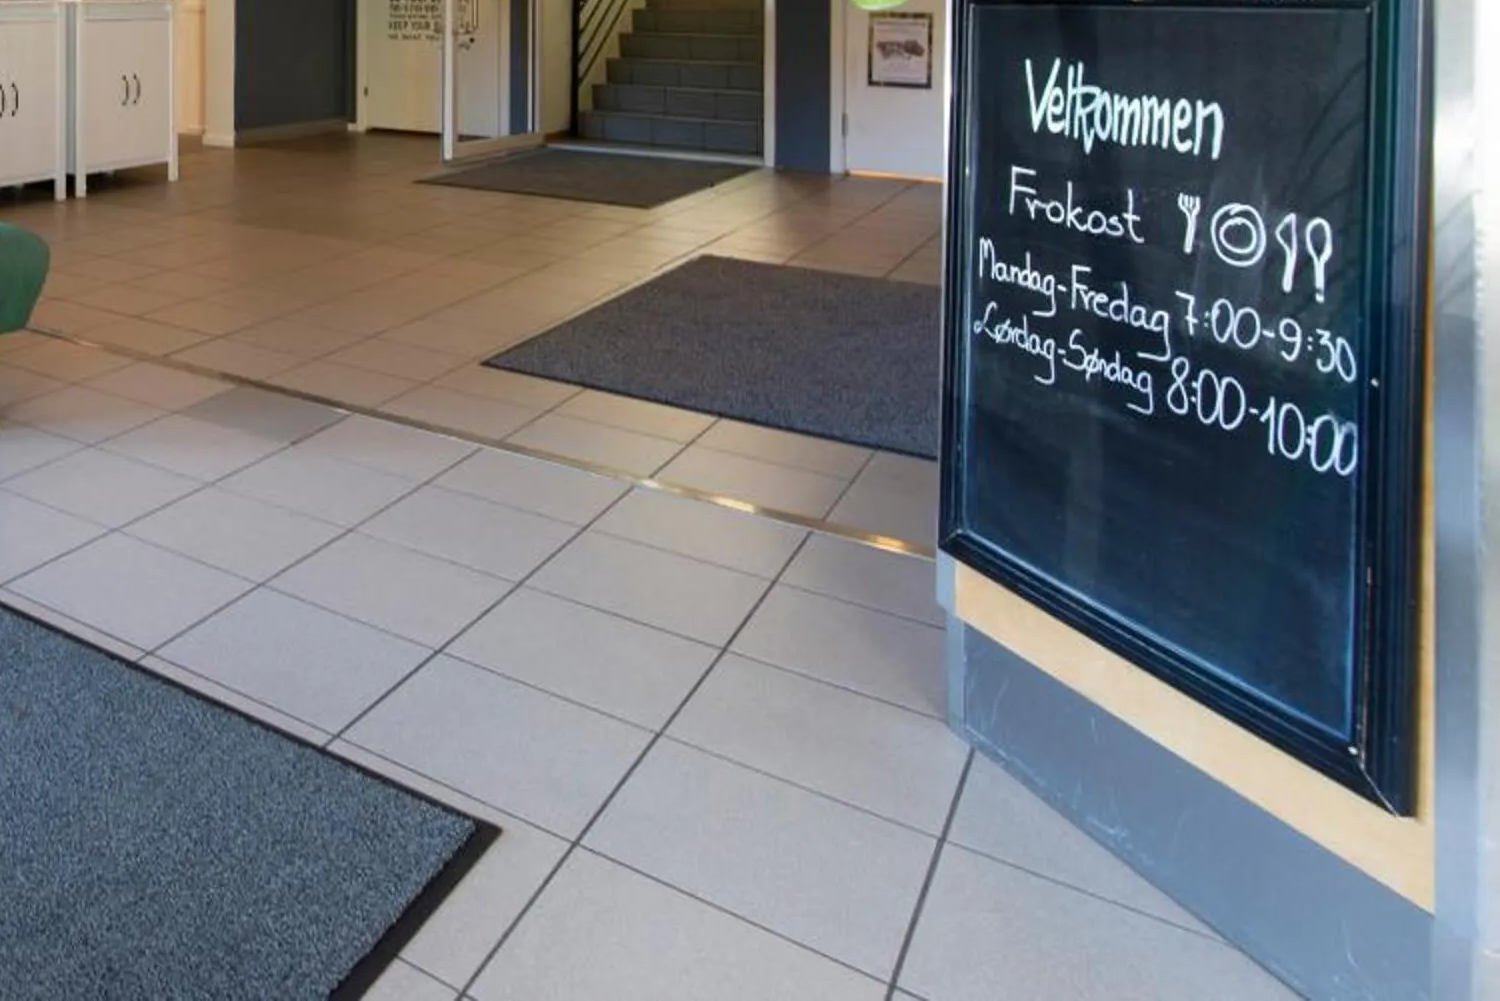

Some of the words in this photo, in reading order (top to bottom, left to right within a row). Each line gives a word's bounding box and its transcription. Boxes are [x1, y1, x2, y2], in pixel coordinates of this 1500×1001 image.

[1025, 57, 1224, 160] Velkommen
[1009, 165, 1145, 244] Frokost
[978, 236, 1171, 362] Mandag-Fredag
[972, 301, 1155, 415] Lørdag-Søndag
